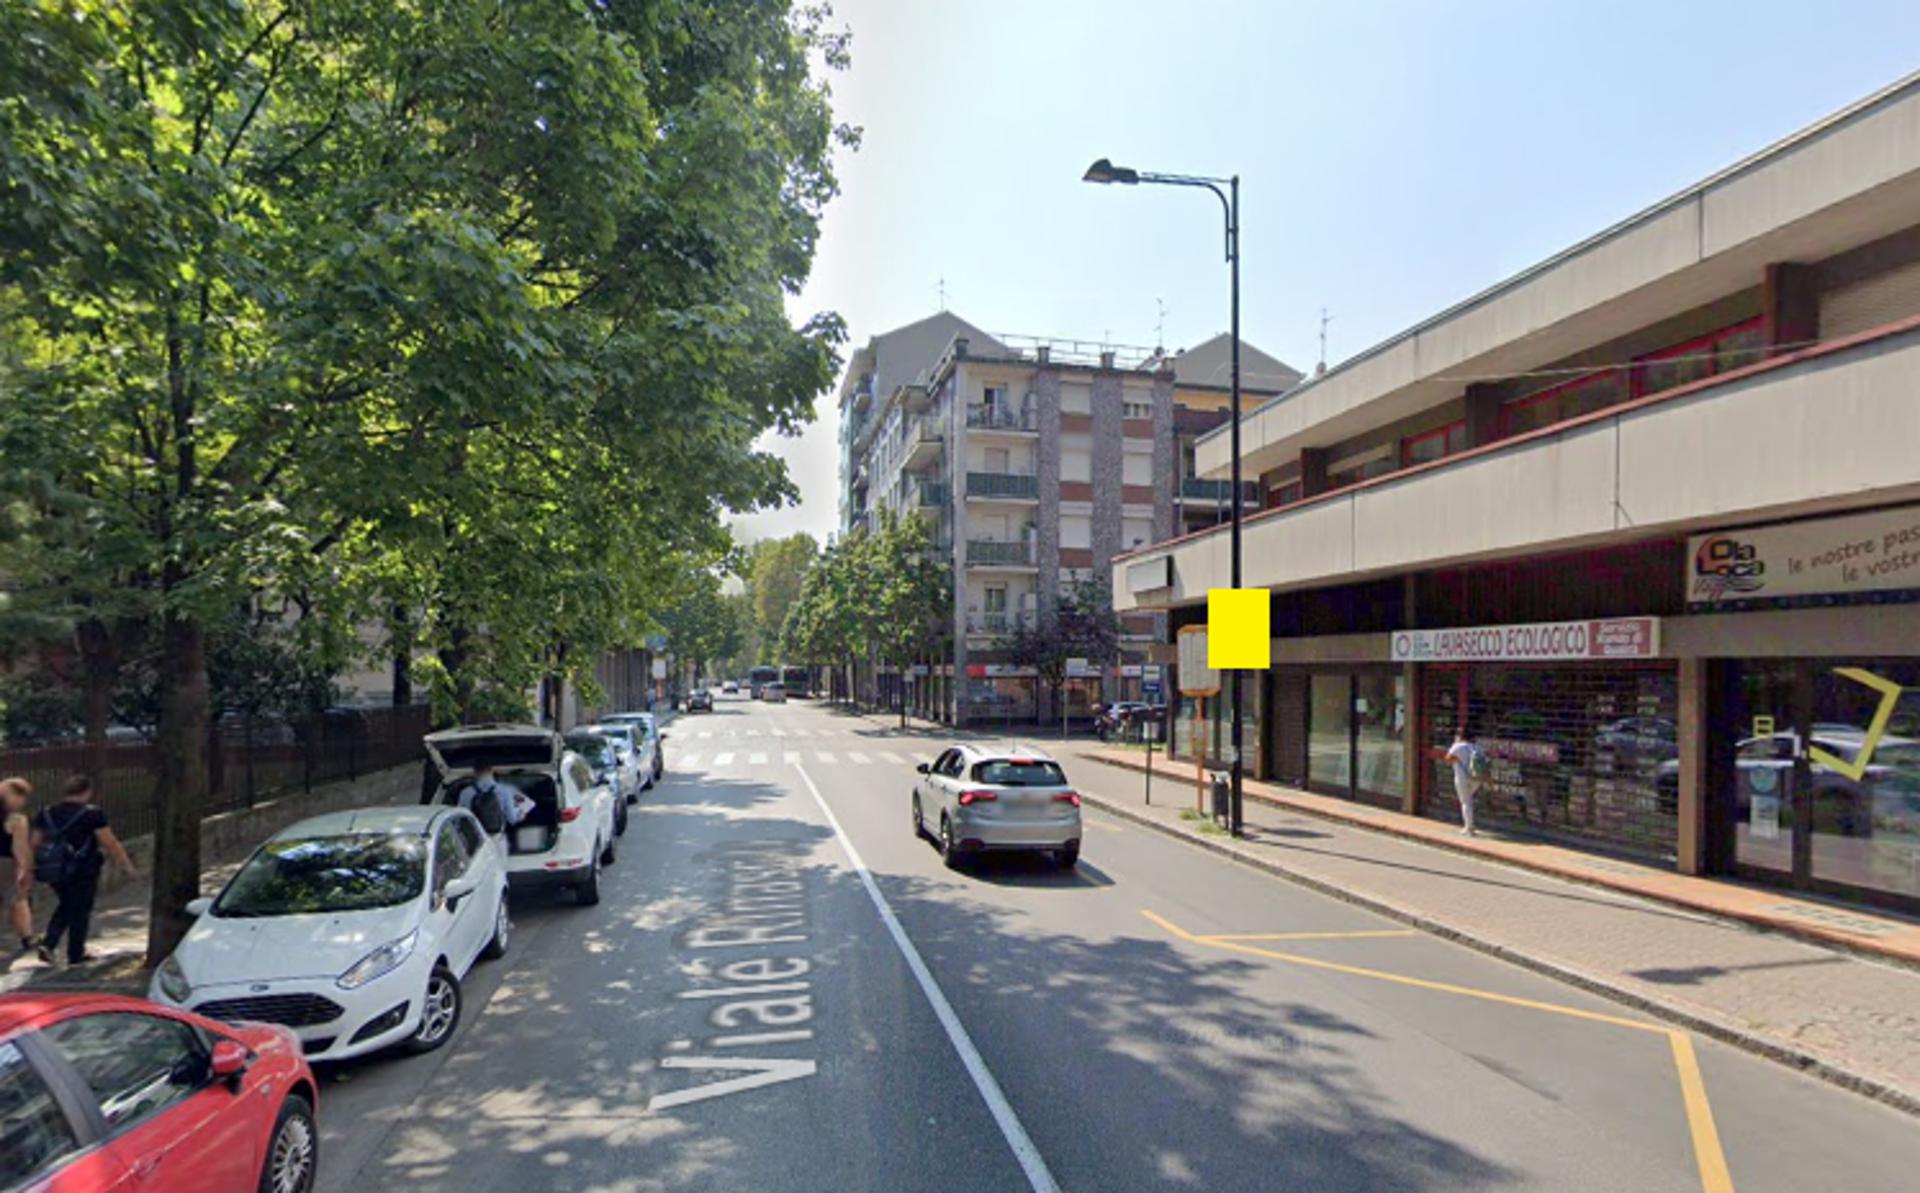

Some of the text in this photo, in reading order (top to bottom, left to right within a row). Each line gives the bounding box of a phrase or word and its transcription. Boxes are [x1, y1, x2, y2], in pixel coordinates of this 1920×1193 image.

[1787, 557, 1803, 575] le
[1811, 539, 1876, 567] nostre
[1842, 563, 1858, 584] le
[1434, 629, 1502, 657] LAVASECCO
[1506, 625, 1587, 656] ECOLOGICO
